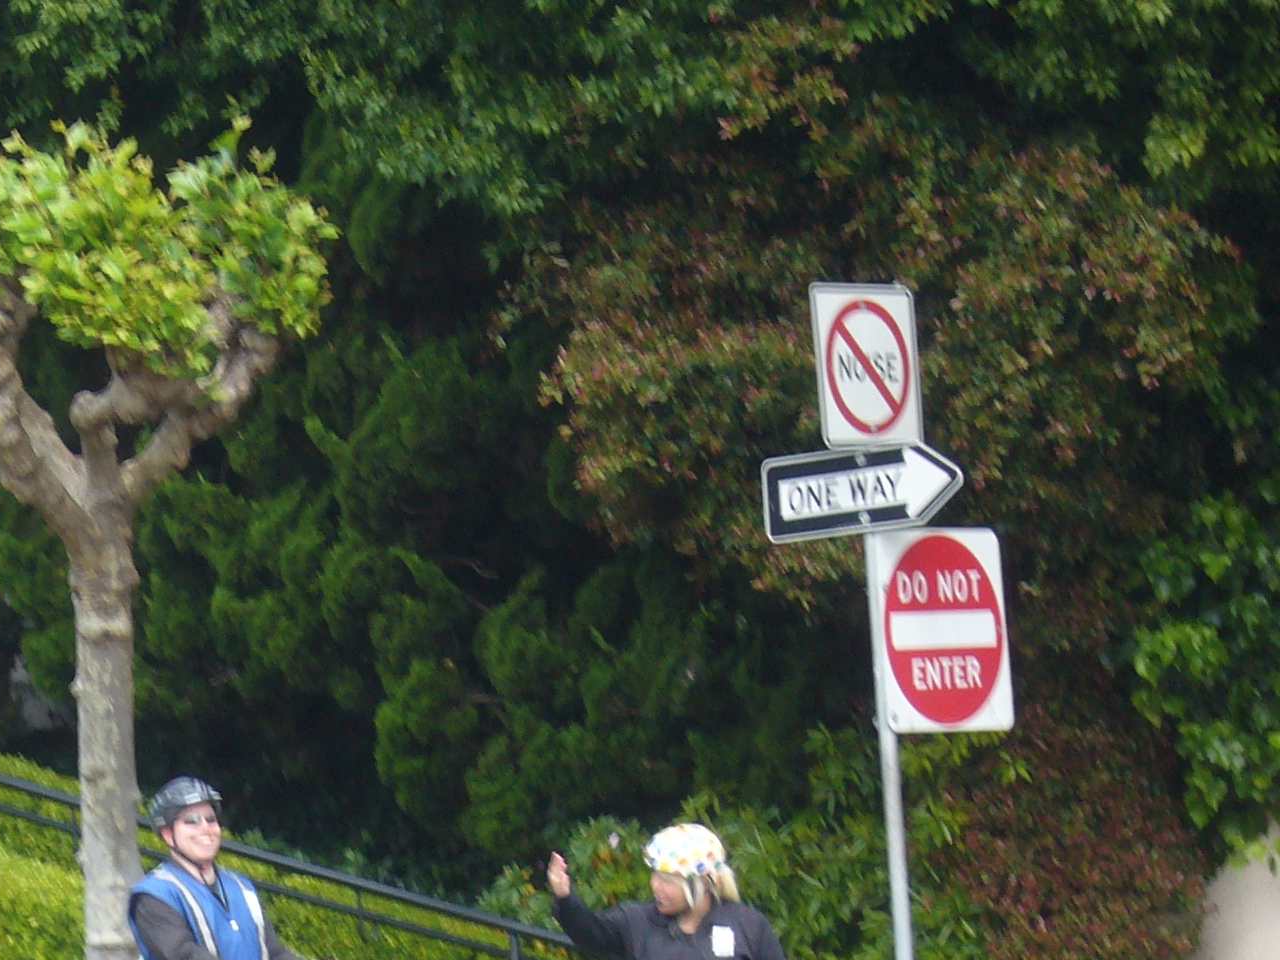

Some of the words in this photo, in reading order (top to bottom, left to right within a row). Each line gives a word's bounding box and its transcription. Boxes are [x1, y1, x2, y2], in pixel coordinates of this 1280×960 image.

[837, 351, 899, 382] NOSE
[789, 476, 840, 515] ONE
[848, 468, 901, 506] WAY
[896, 569, 928, 604] DO
[936, 568, 981, 603] NOT
[911, 655, 982, 691] ENTER
